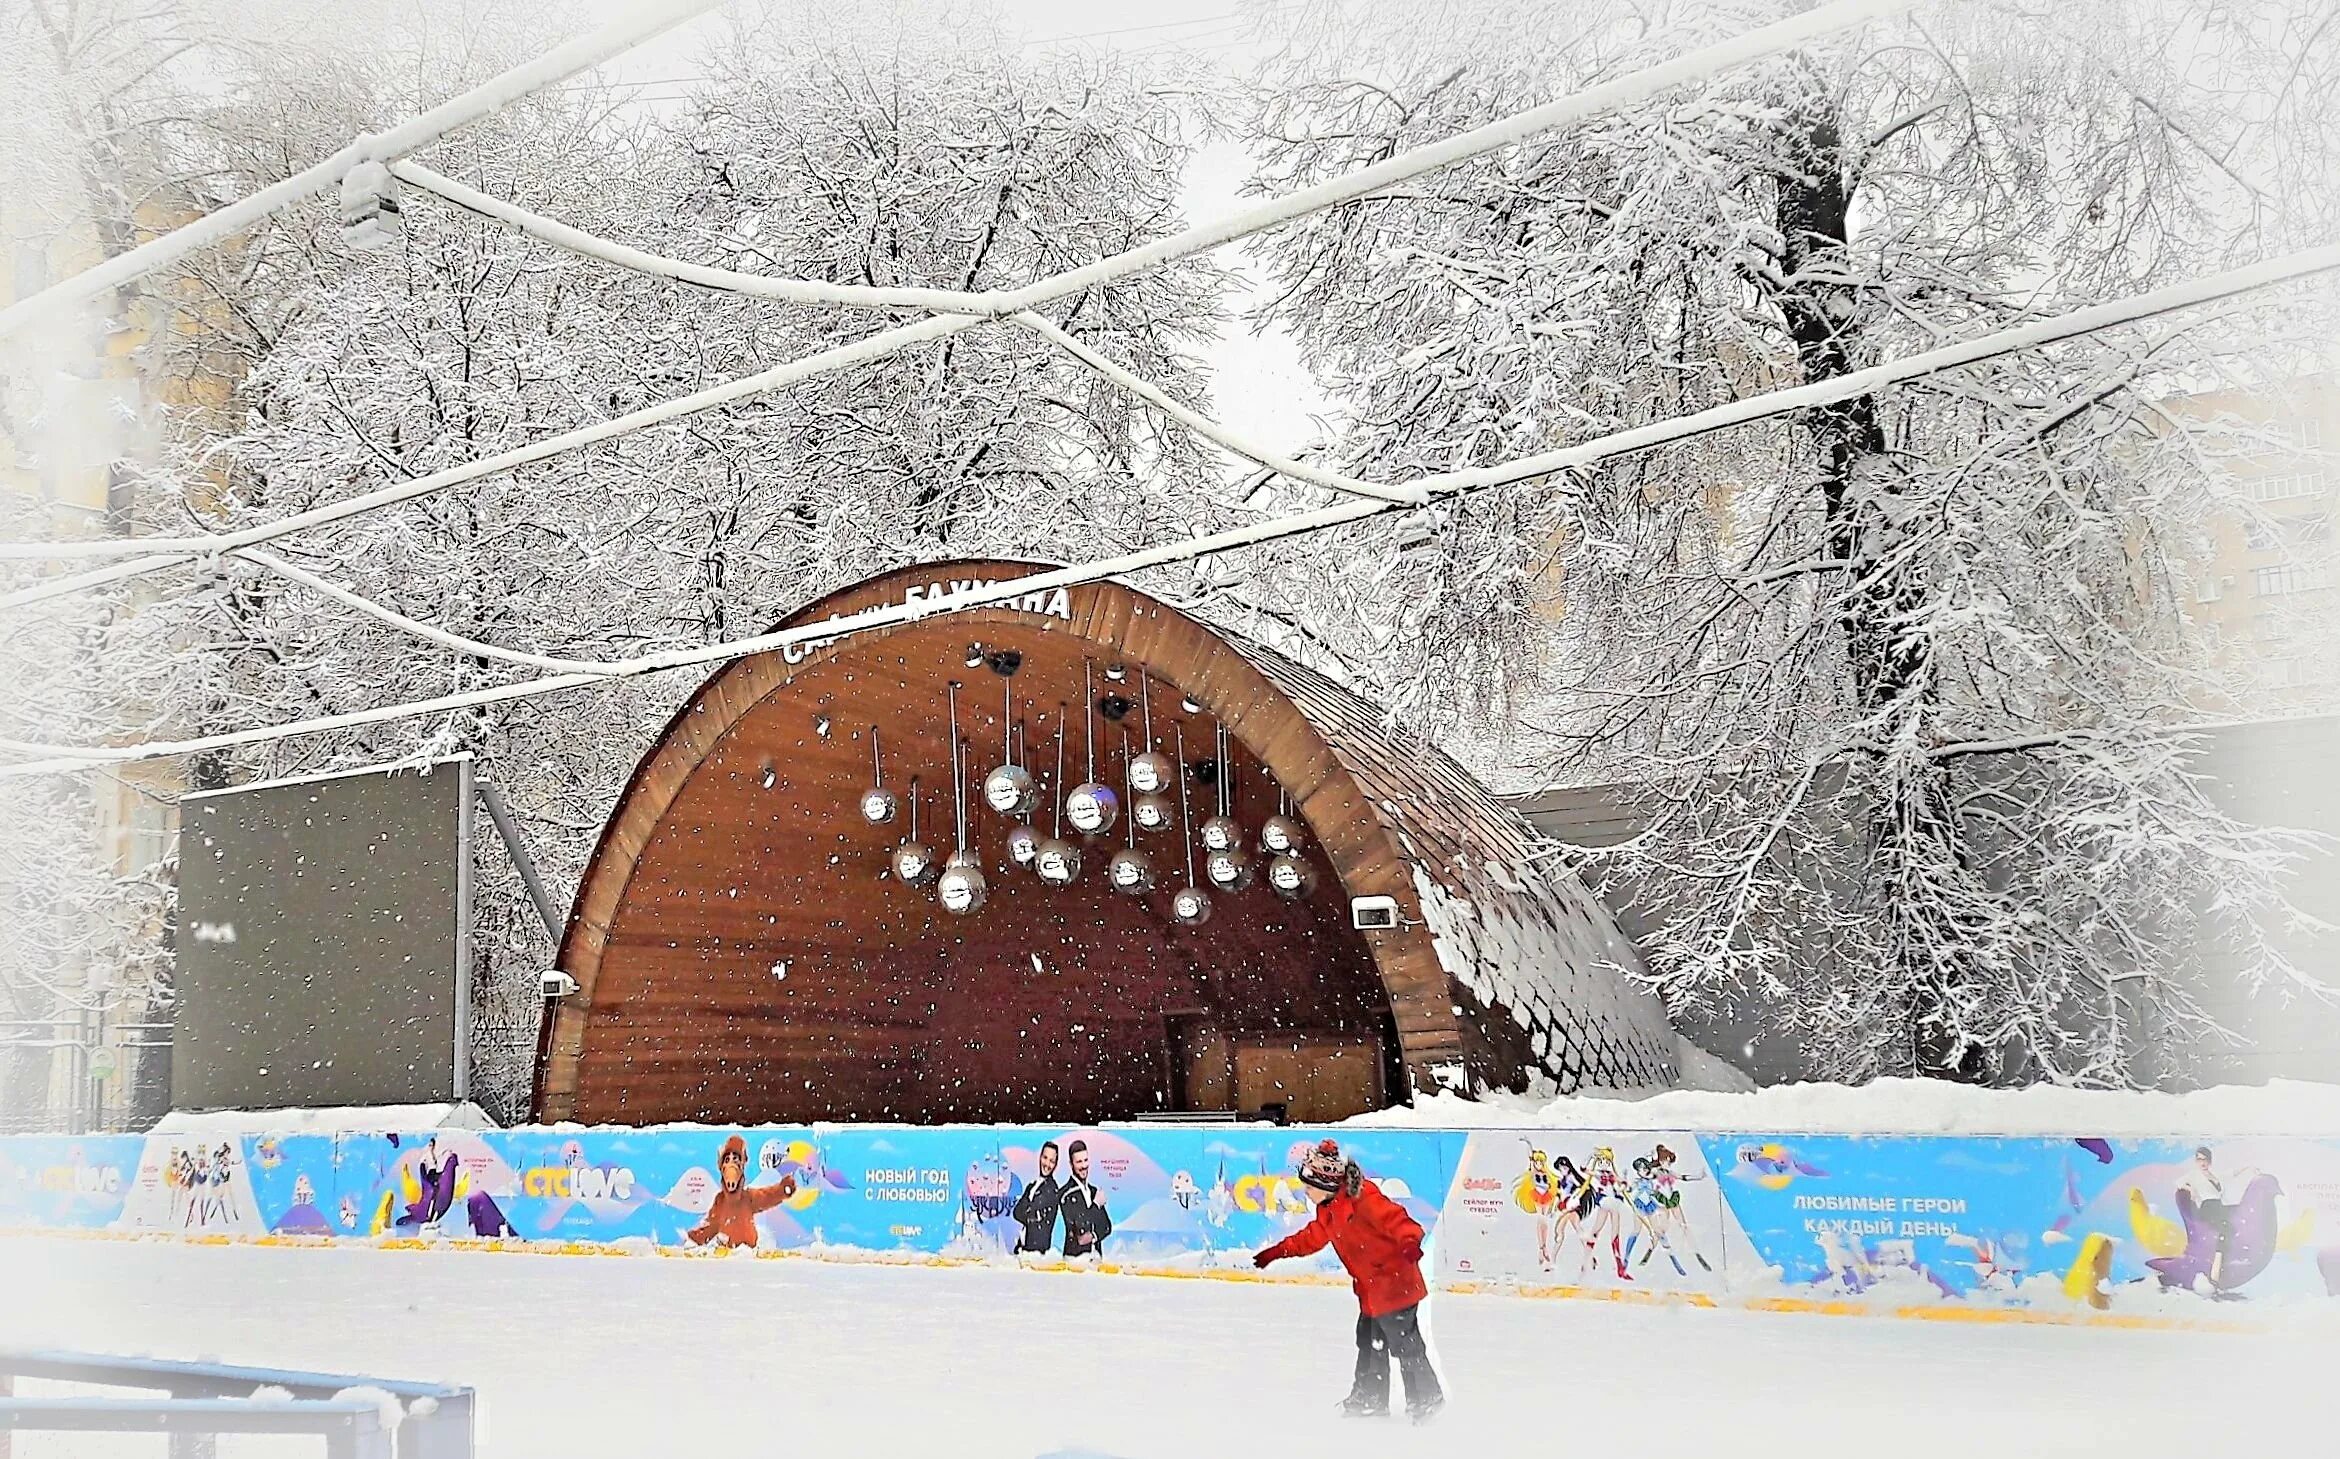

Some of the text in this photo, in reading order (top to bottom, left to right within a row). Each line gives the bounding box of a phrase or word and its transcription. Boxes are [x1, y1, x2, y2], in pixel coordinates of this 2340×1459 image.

[865, 1166, 950, 1187] НОВЫЙ ГОД
[865, 1188, 950, 1203] С ЛЮБОВЬЮ!
[1793, 1195, 1967, 1214] ЛЮБИМЫЕ ГЕРОИ
[1804, 1217, 1895, 1236] КАЖДЫЙ
